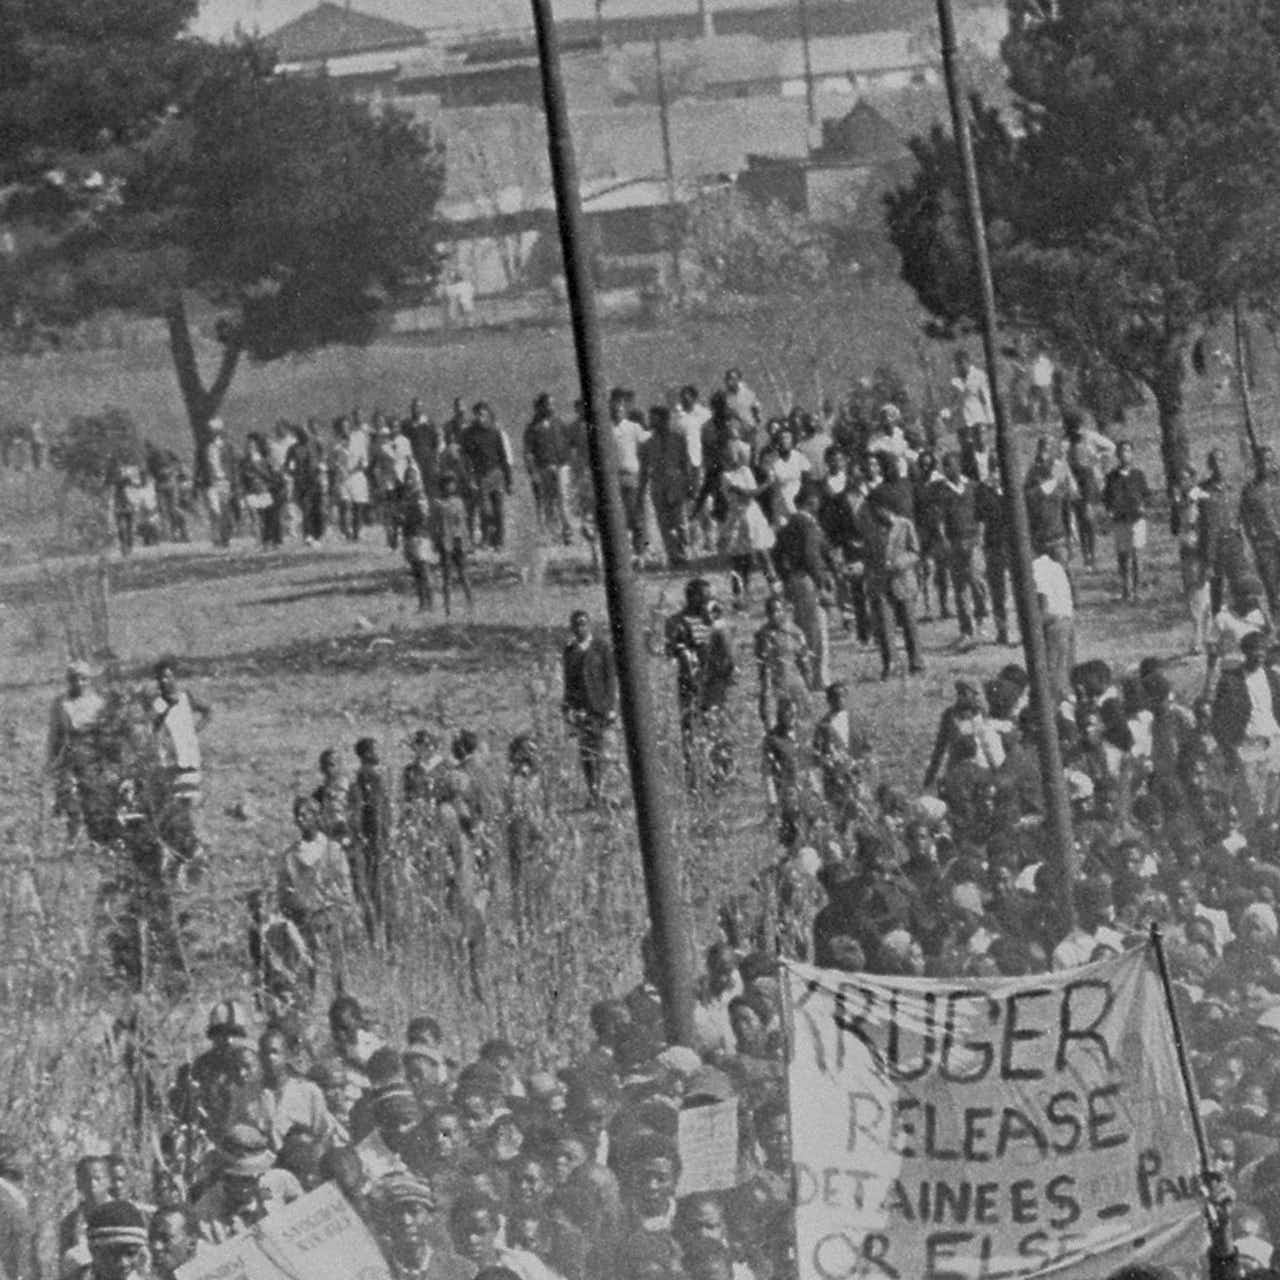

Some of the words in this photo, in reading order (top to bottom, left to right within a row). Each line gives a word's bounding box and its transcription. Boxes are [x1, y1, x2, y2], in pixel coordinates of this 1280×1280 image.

[846, 1083, 1130, 1162] RELEASE
[794, 1163, 1081, 1229] DETAINEES
[813, 1233, 900, 1280] OR
